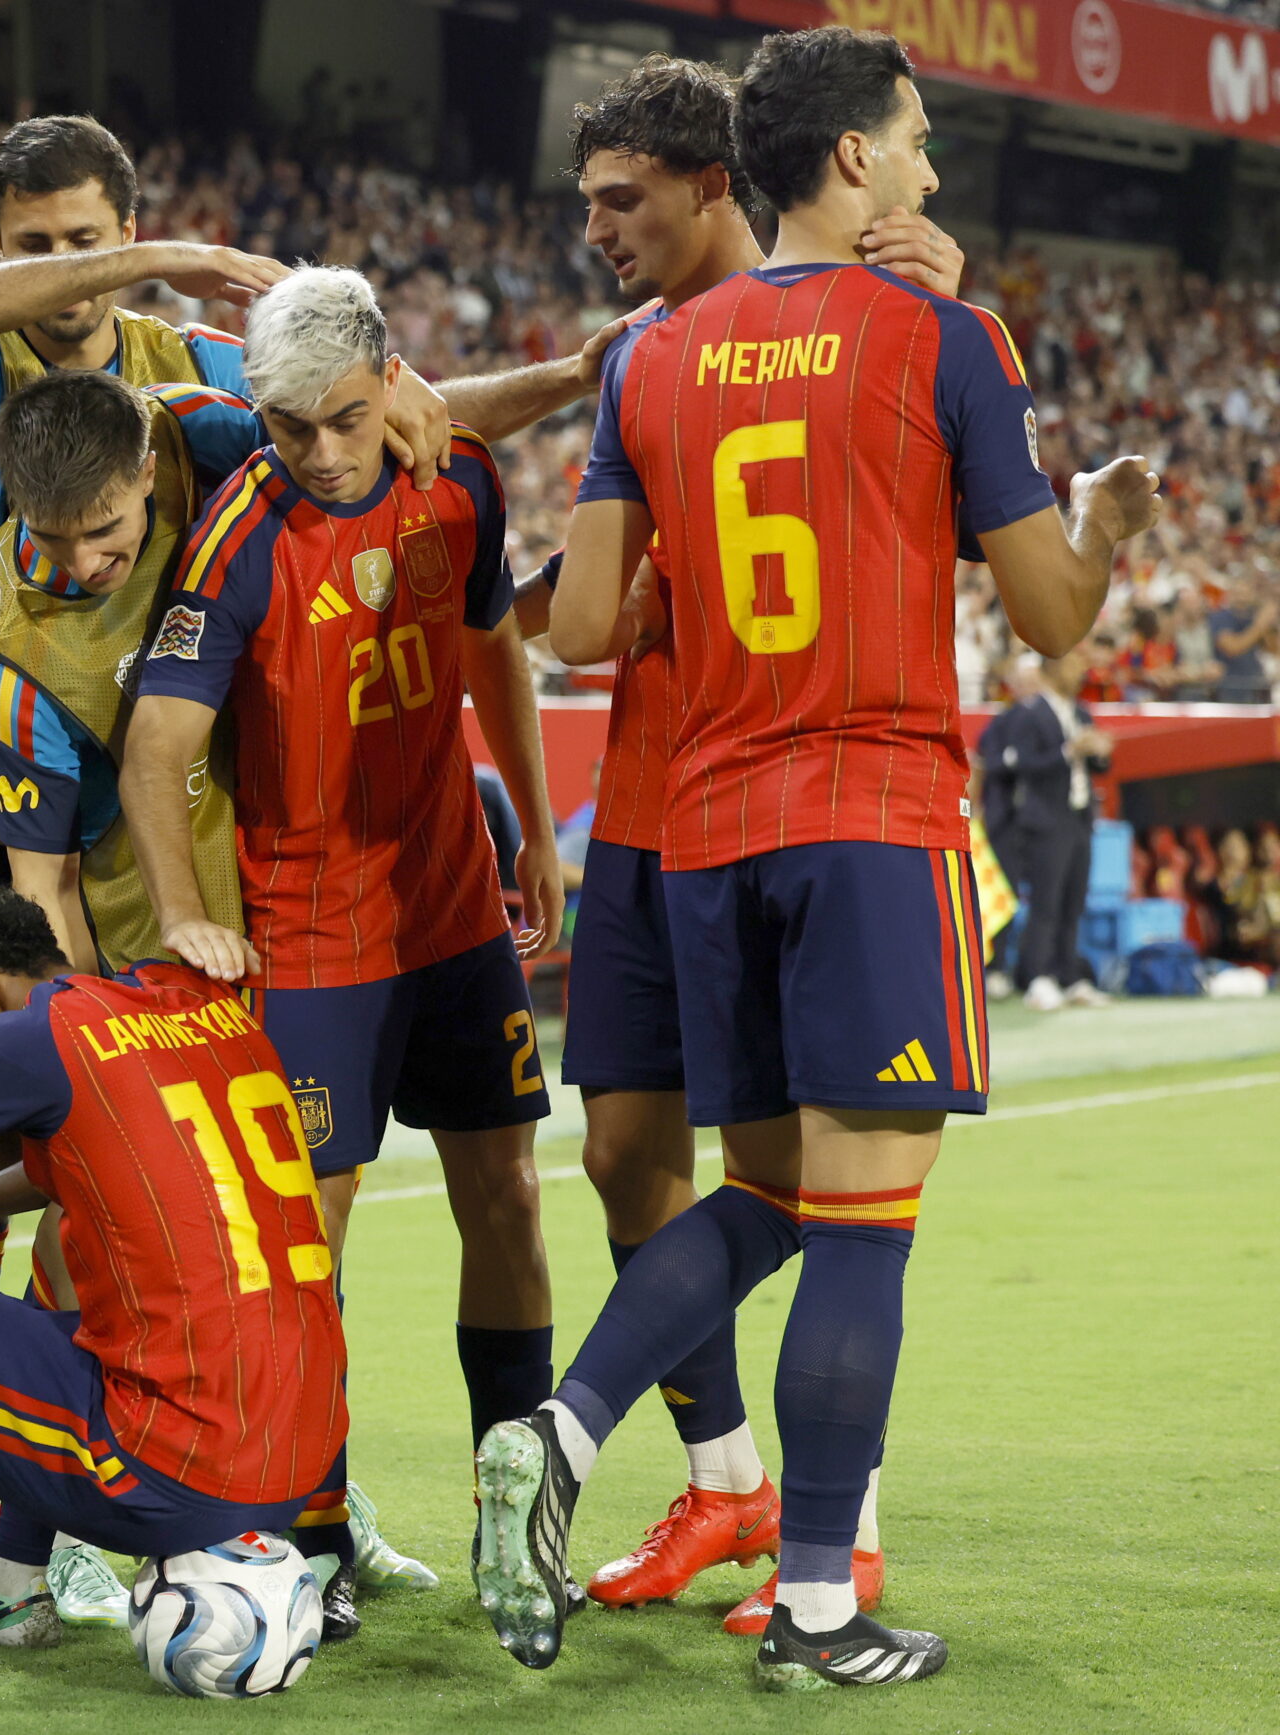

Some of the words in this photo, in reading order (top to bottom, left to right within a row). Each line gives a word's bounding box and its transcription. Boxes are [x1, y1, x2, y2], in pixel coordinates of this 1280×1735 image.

[696, 333, 841, 387] MERINO
[712, 419, 821, 655] 6
[368, 587, 386, 598] FIFA
[348, 623, 435, 727] 20
[79, 1012, 209, 1062] LAMINE
[159, 1070, 333, 1295] 19
